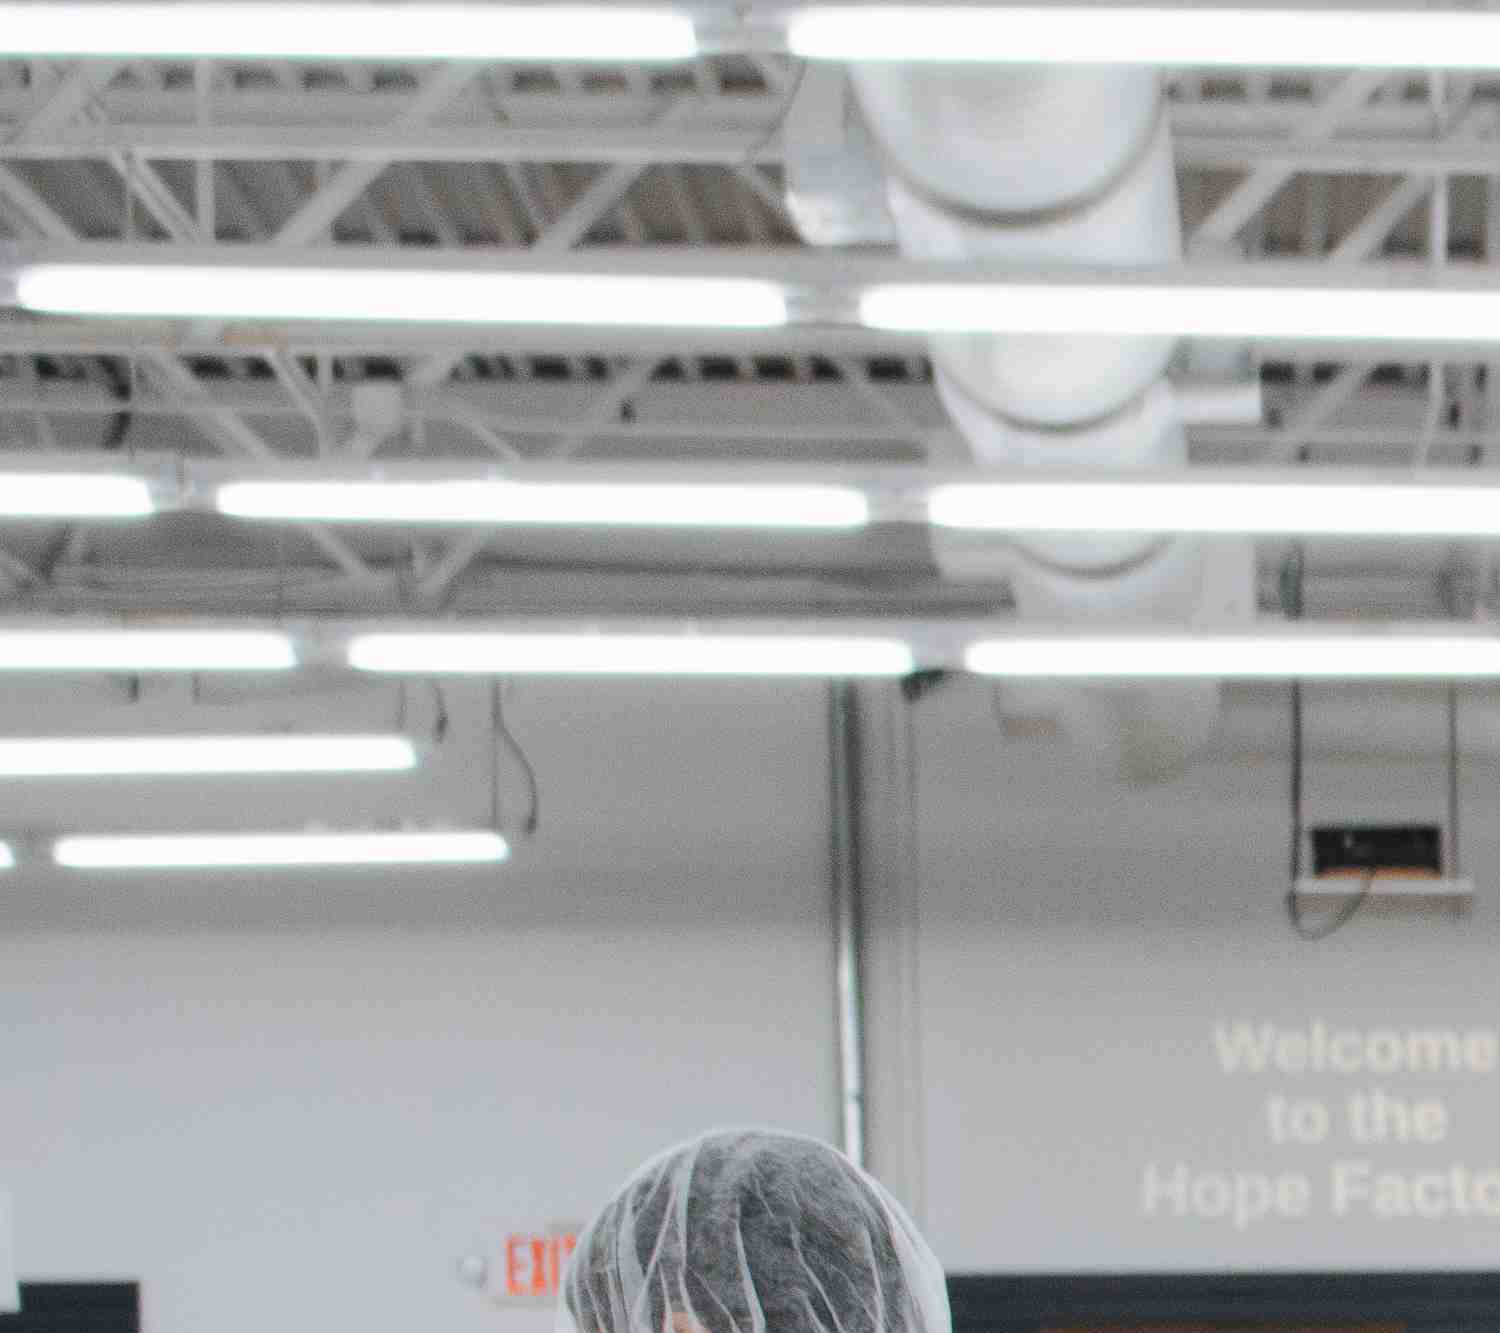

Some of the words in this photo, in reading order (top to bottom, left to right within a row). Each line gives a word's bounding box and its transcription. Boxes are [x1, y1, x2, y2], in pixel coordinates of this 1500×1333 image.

[1213, 1020, 1499, 1074] Welcome
[1266, 1091, 1329, 1143] to
[1346, 1088, 1449, 1143] the
[1141, 1161, 1310, 1230] Hope
